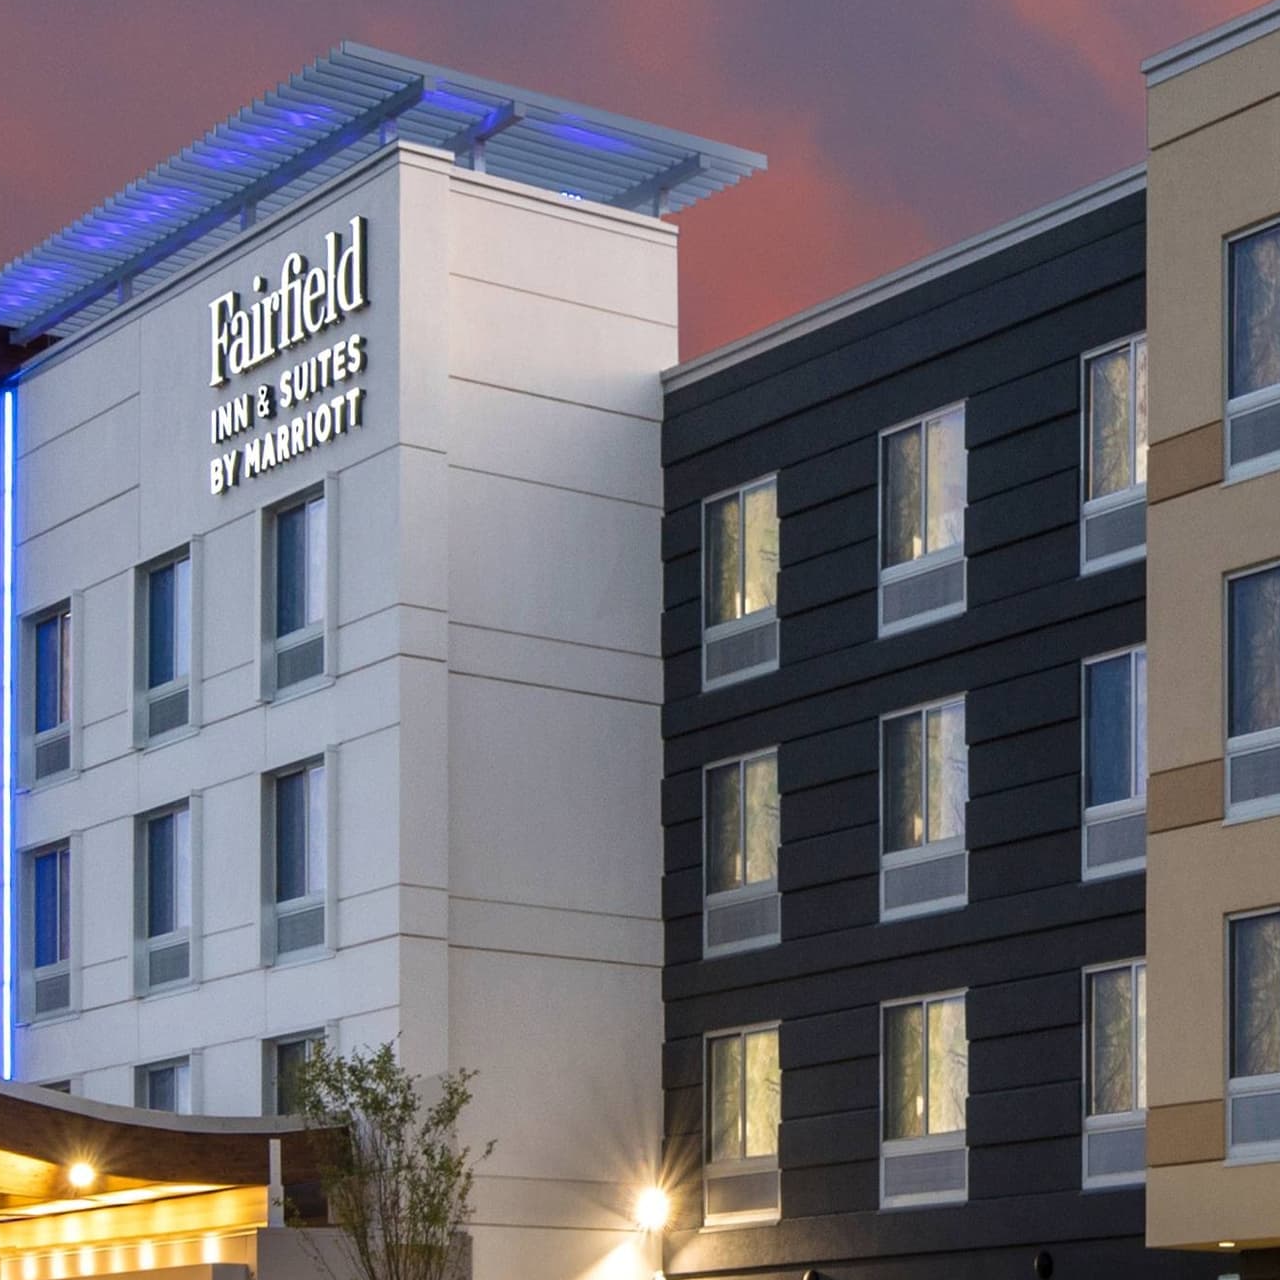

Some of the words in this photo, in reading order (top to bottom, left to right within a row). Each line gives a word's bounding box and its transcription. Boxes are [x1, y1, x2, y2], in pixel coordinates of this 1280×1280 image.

[208, 215, 367, 387] Fairfield
[209, 449, 240, 495] BY
[244, 387, 363, 478] MARRIOTT
[210, 393, 250, 444] INN
[256, 384, 271, 418] &
[279, 333, 364, 409] SUITES
